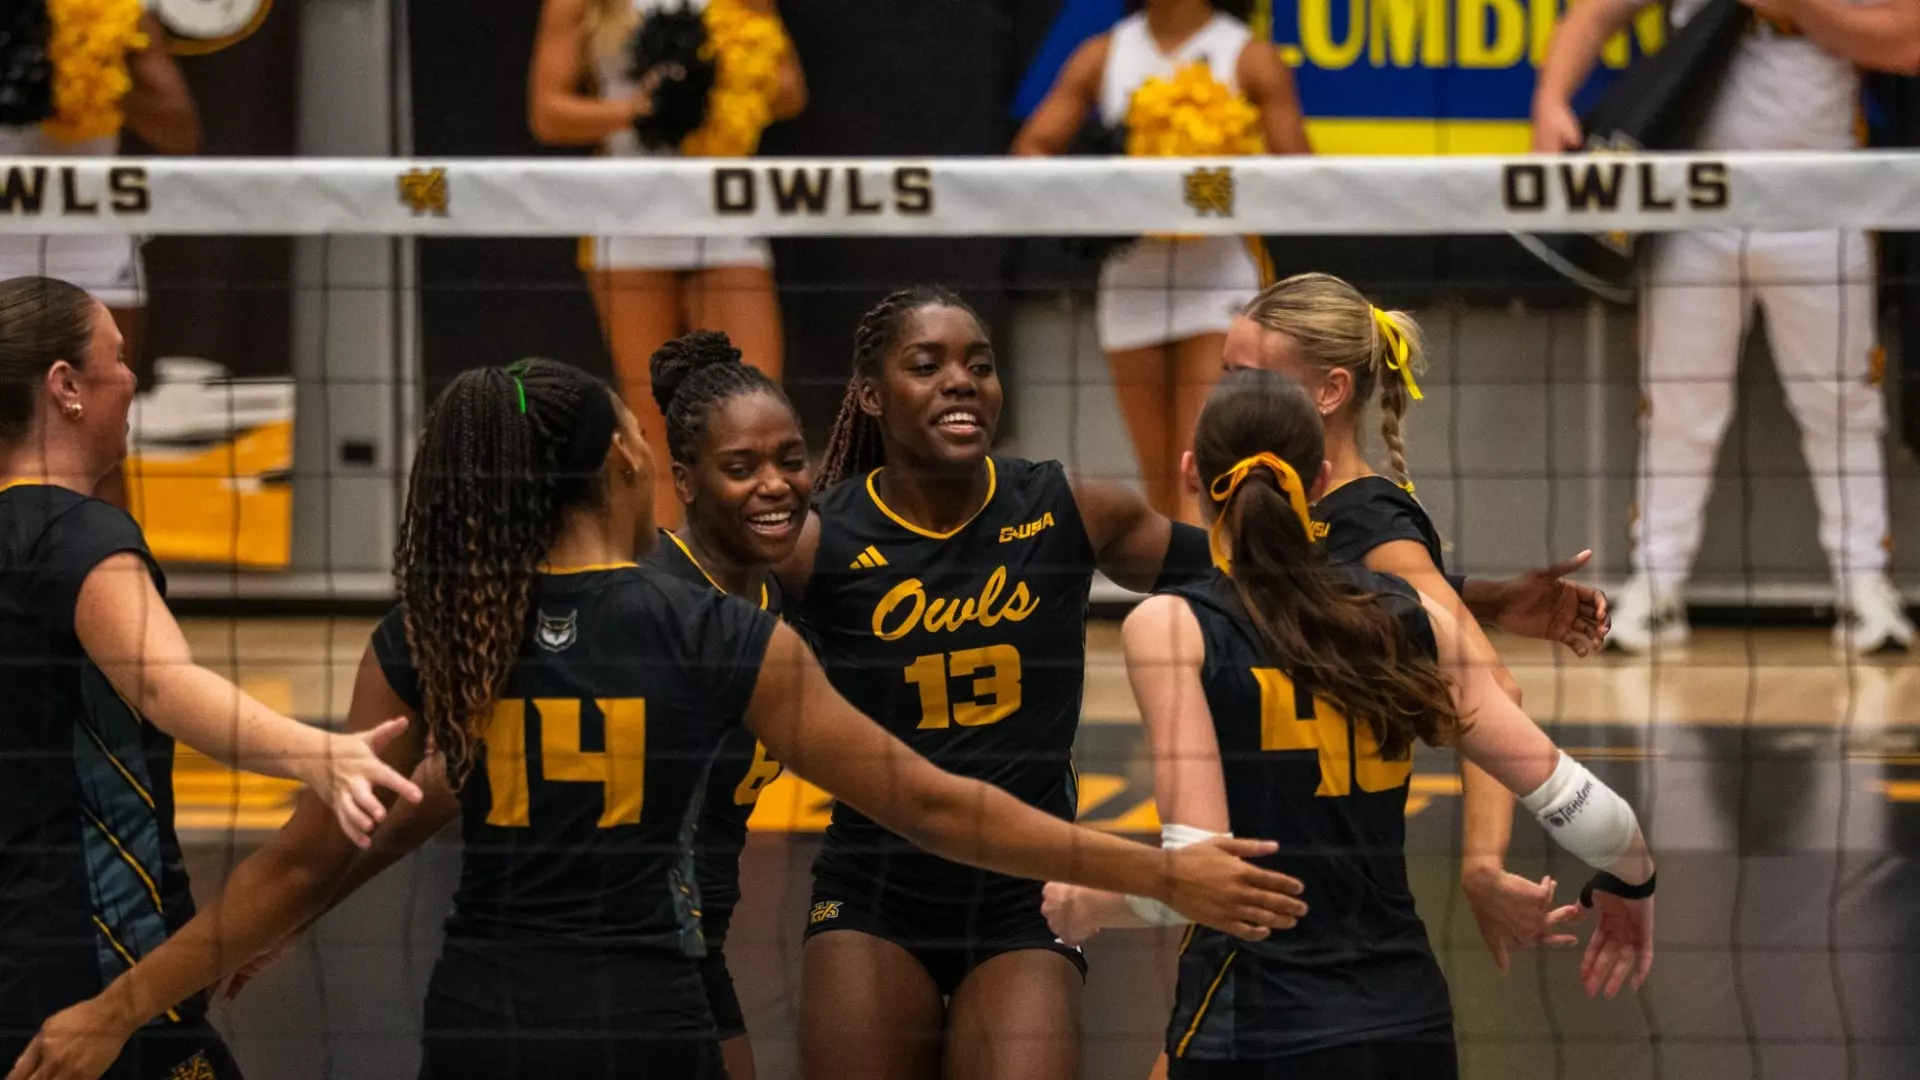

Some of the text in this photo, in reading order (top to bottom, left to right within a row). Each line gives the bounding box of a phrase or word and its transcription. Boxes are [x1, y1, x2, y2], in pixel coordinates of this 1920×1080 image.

[713, 167, 933, 215] OWLS
[1503, 162, 1729, 212] OWLS
[871, 565, 1040, 641] Owls
[904, 644, 1022, 729] 13
[478, 696, 646, 828] 14
[1543, 779, 1593, 824] Tandem
